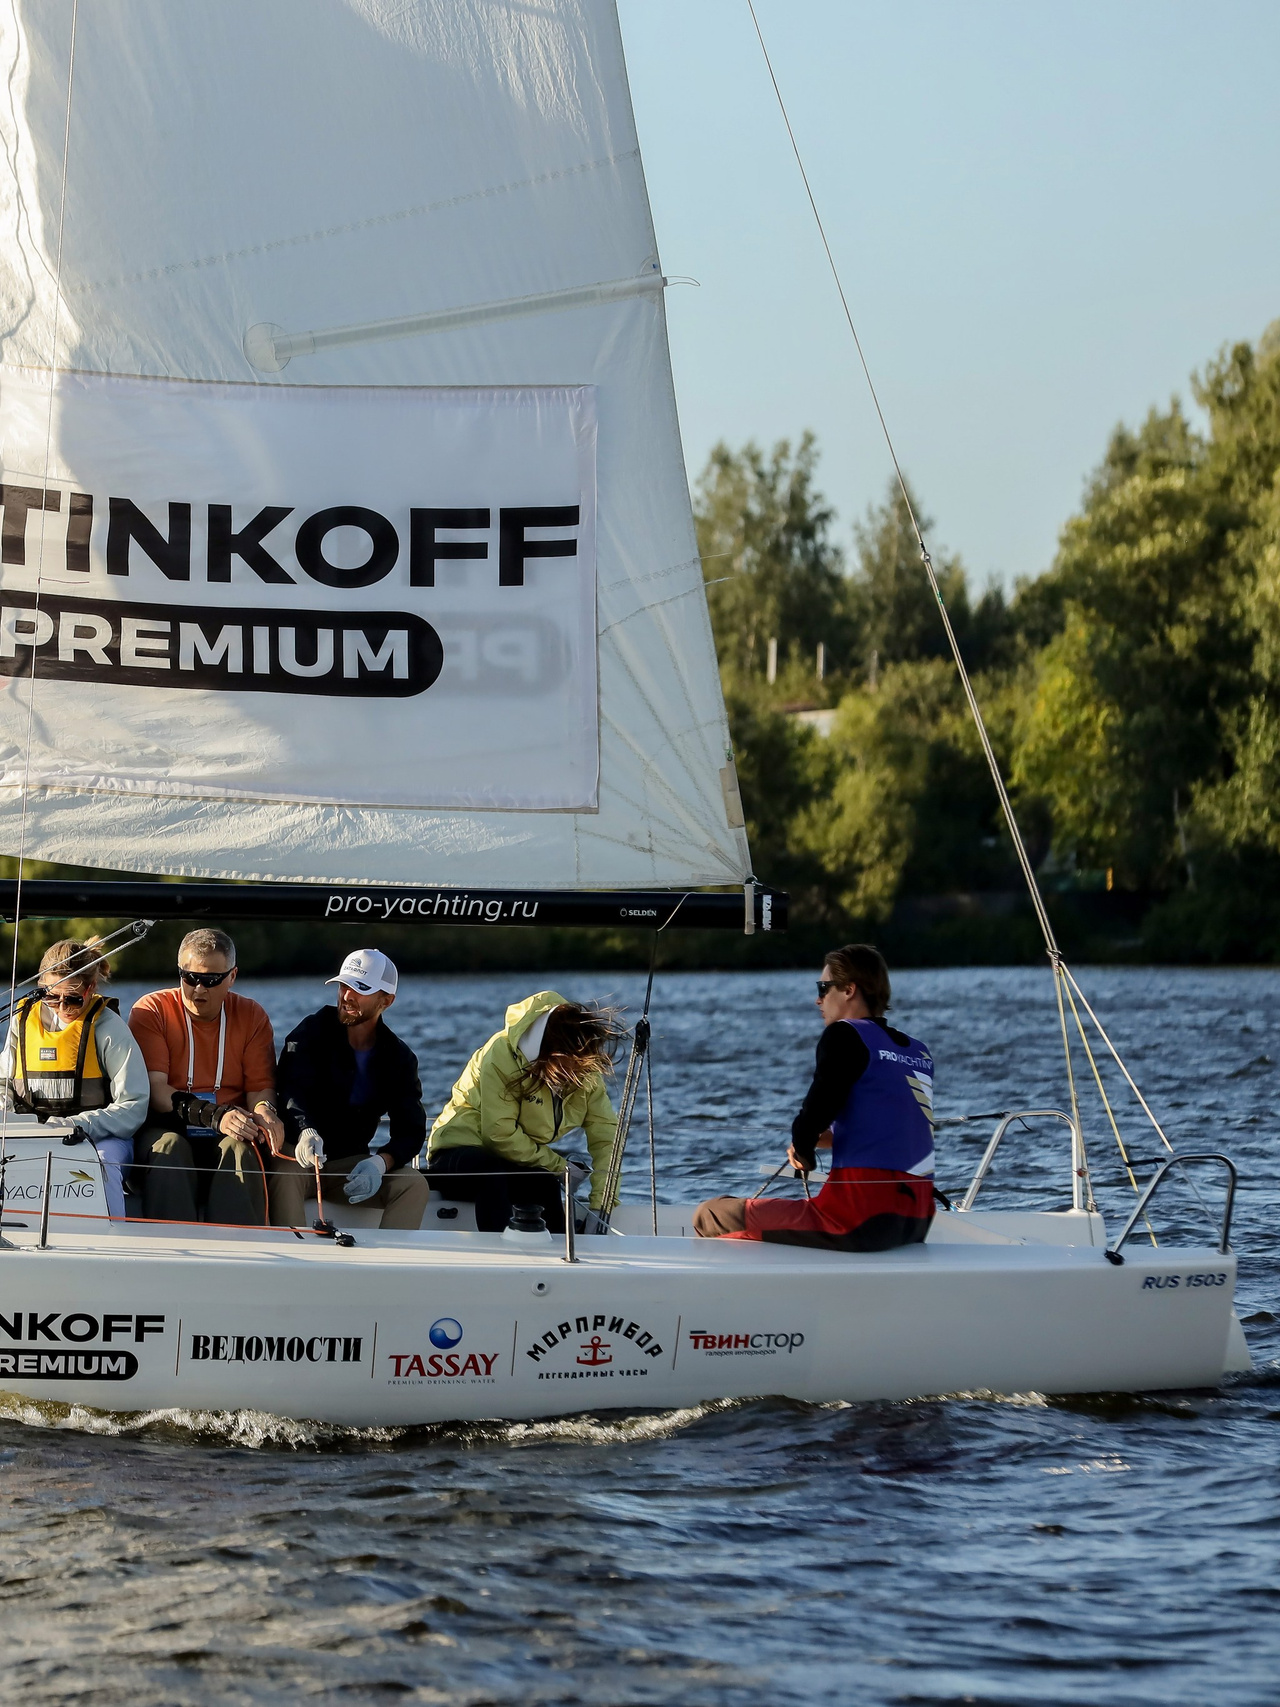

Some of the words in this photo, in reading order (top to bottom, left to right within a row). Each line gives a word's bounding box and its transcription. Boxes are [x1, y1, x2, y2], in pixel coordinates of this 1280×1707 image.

[325, 893, 539, 922] pro-yachting.ru
[878, 1049, 933, 1070] PROYACHTIN
[1141, 1274, 1181, 1290] RUS
[1185, 1272, 1228, 1288] 1503
[189, 1334, 363, 1364] ВЕДОМОСТИ
[526, 1314, 664, 1362] МОРПРИБОР
[387, 1352, 500, 1378] TASSAY
[538, 1370, 615, 1380] ЛЕГЕНДАРНЫЕ
[619, 1368, 648, 1377] ЧАСЫ
